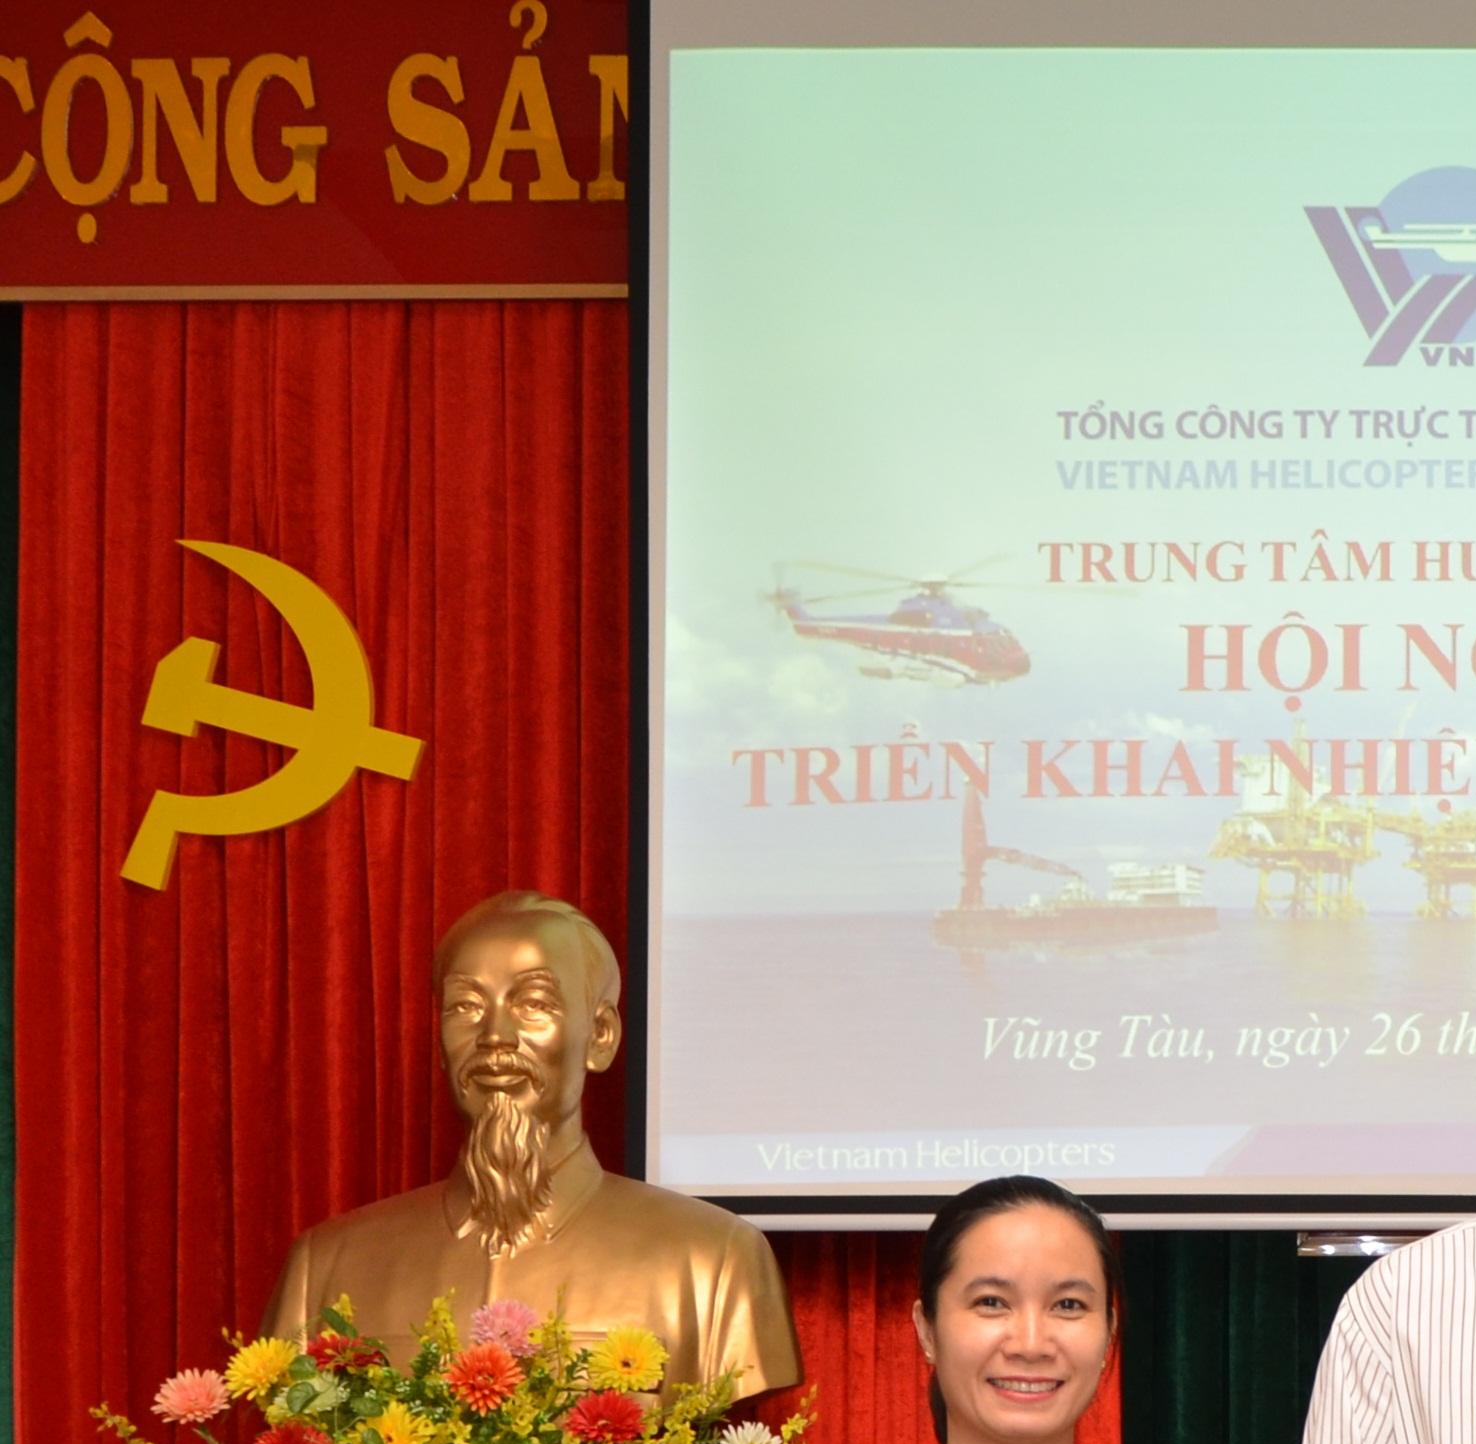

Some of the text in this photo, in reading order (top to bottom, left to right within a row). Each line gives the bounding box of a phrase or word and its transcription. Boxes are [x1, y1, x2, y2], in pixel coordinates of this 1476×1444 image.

[1056, 400, 1165, 440] TỔNG
[1175, 404, 1284, 440] CÔNG
[1293, 410, 1340, 439] TY
[1349, 405, 1449, 447] TRỰC
[1055, 459, 1239, 490] VIETNAM
[1038, 541, 1247, 583] TRUNG
[1261, 528, 1395, 582] TÂM
[1178, 611, 1369, 713] HỘI
[732, 722, 995, 808] TRIỂN
[1021, 738, 1239, 799] KHAI
[981, 1016, 1102, 1071] Vũng
[1118, 1013, 1216, 1064] Tàu,
[1236, 1015, 1351, 1069] ngày
[1365, 1013, 1422, 1056] 26
[757, 1138, 1116, 1174] Vietnam Helicopters
